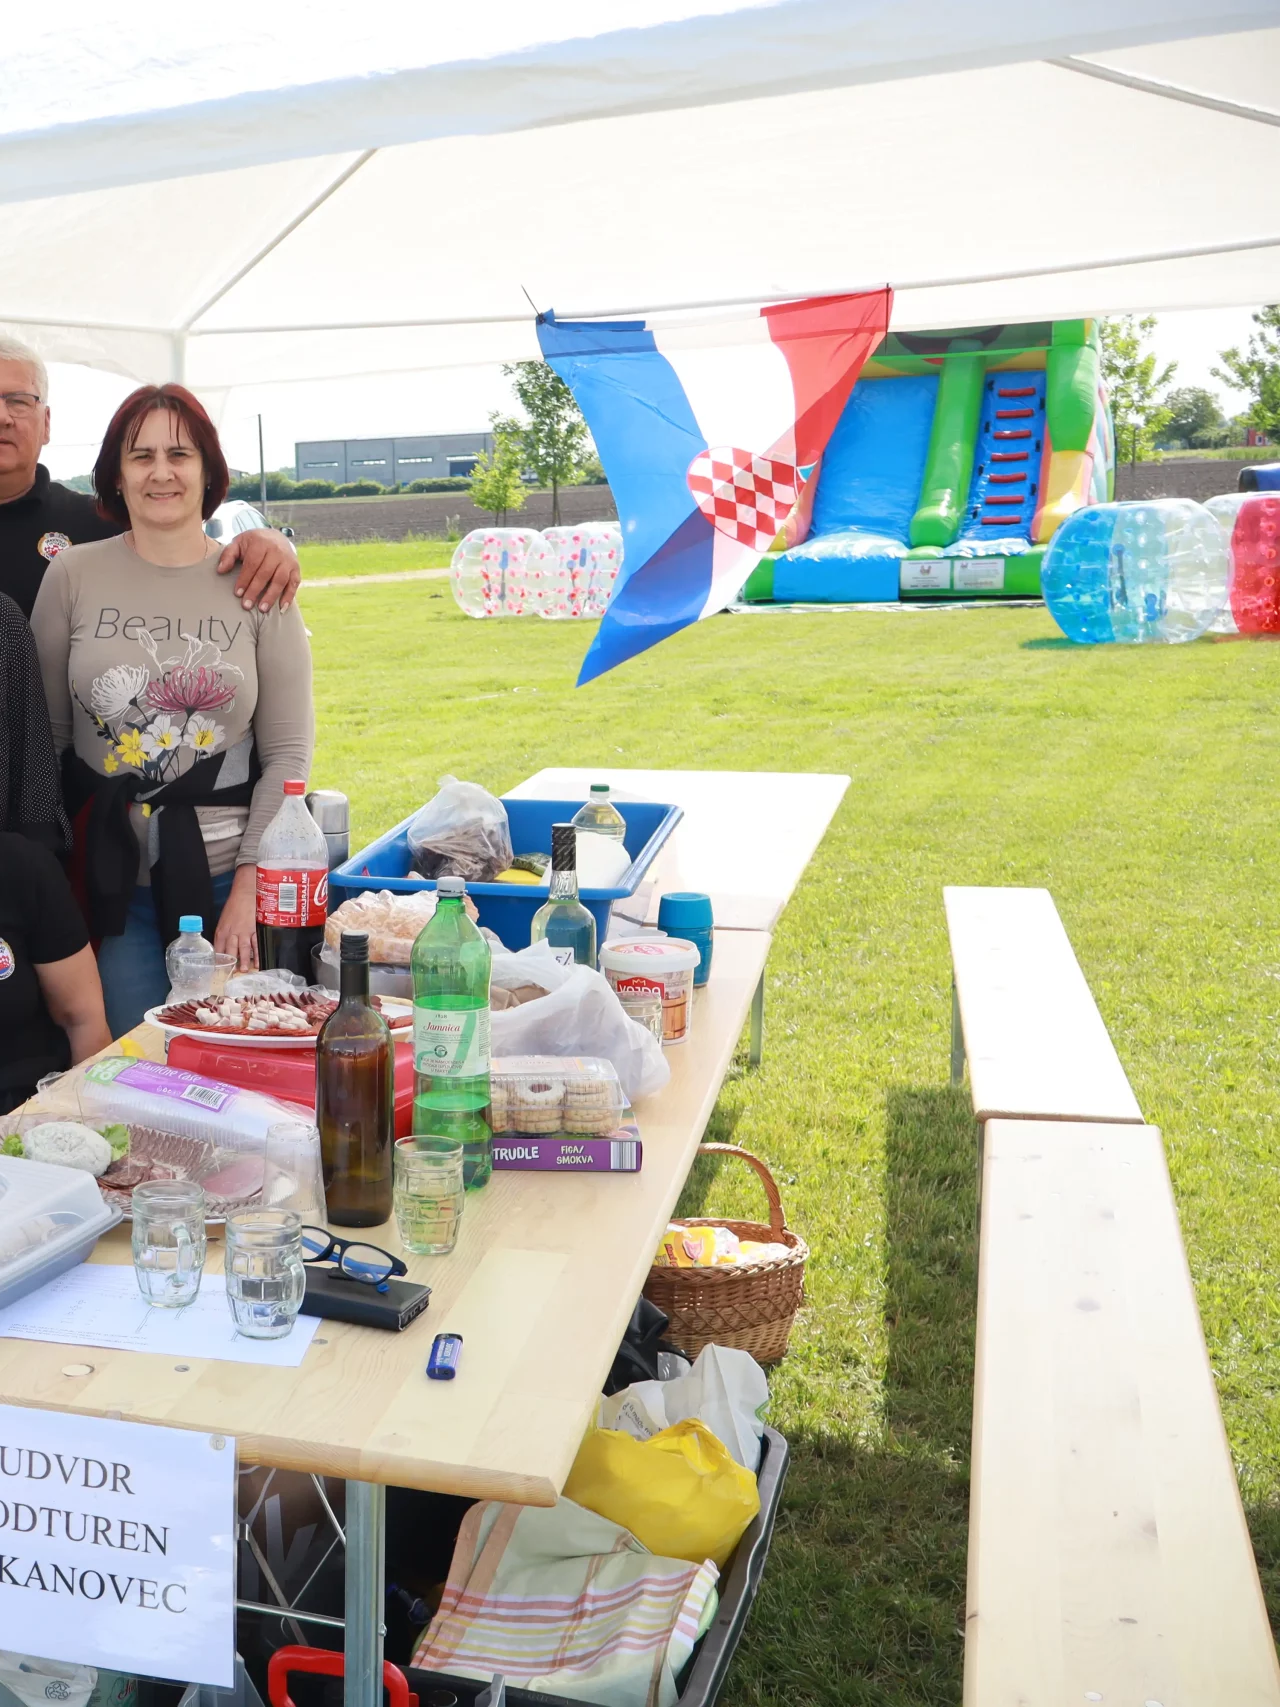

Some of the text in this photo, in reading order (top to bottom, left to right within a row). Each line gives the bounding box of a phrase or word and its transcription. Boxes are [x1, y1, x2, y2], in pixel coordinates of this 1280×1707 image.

[94, 607, 242, 652] Beauty
[422, 1021, 461, 1033] Jamnica
[493, 1146, 540, 1161] TRUDLE
[556, 1156, 594, 1165] SMOKVA
